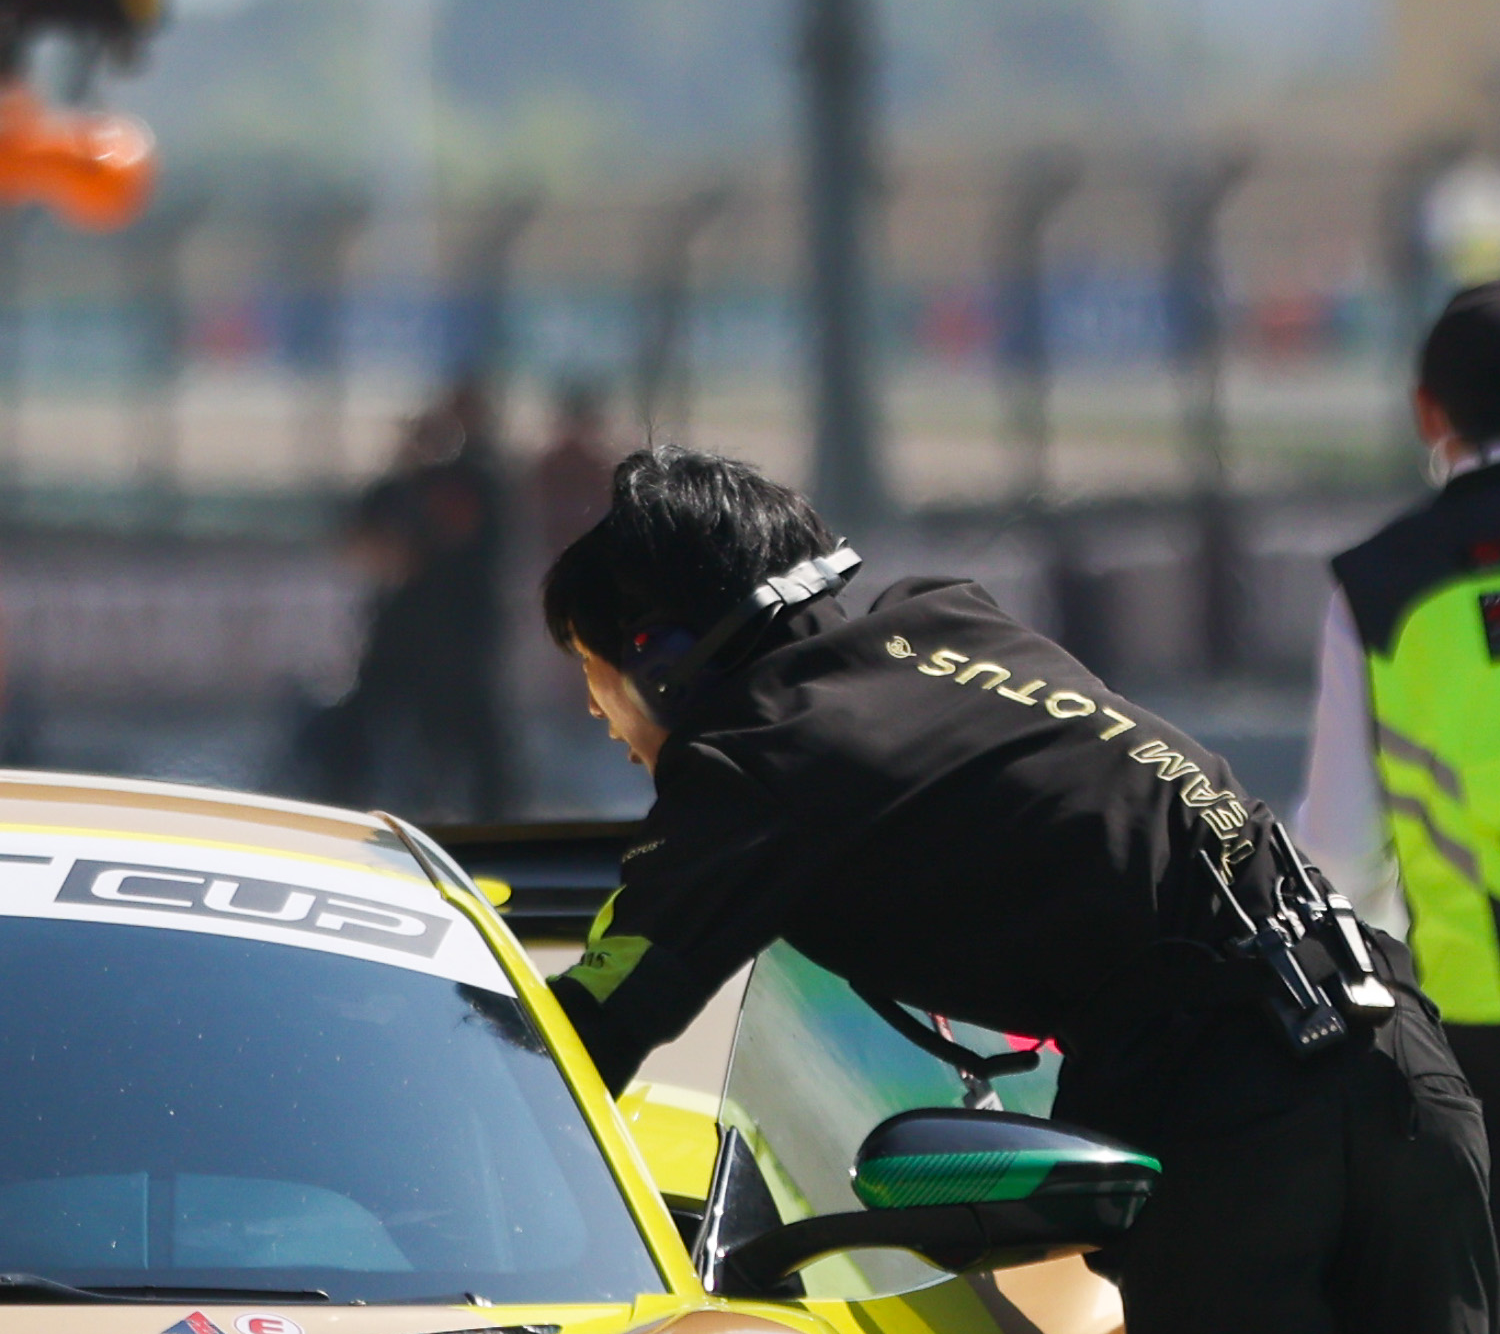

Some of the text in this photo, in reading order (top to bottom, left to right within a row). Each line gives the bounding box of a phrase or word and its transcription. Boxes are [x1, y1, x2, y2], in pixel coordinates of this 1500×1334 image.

[916, 647, 1256, 887] TEAM LOTUS
[80, 866, 436, 944] CUP
